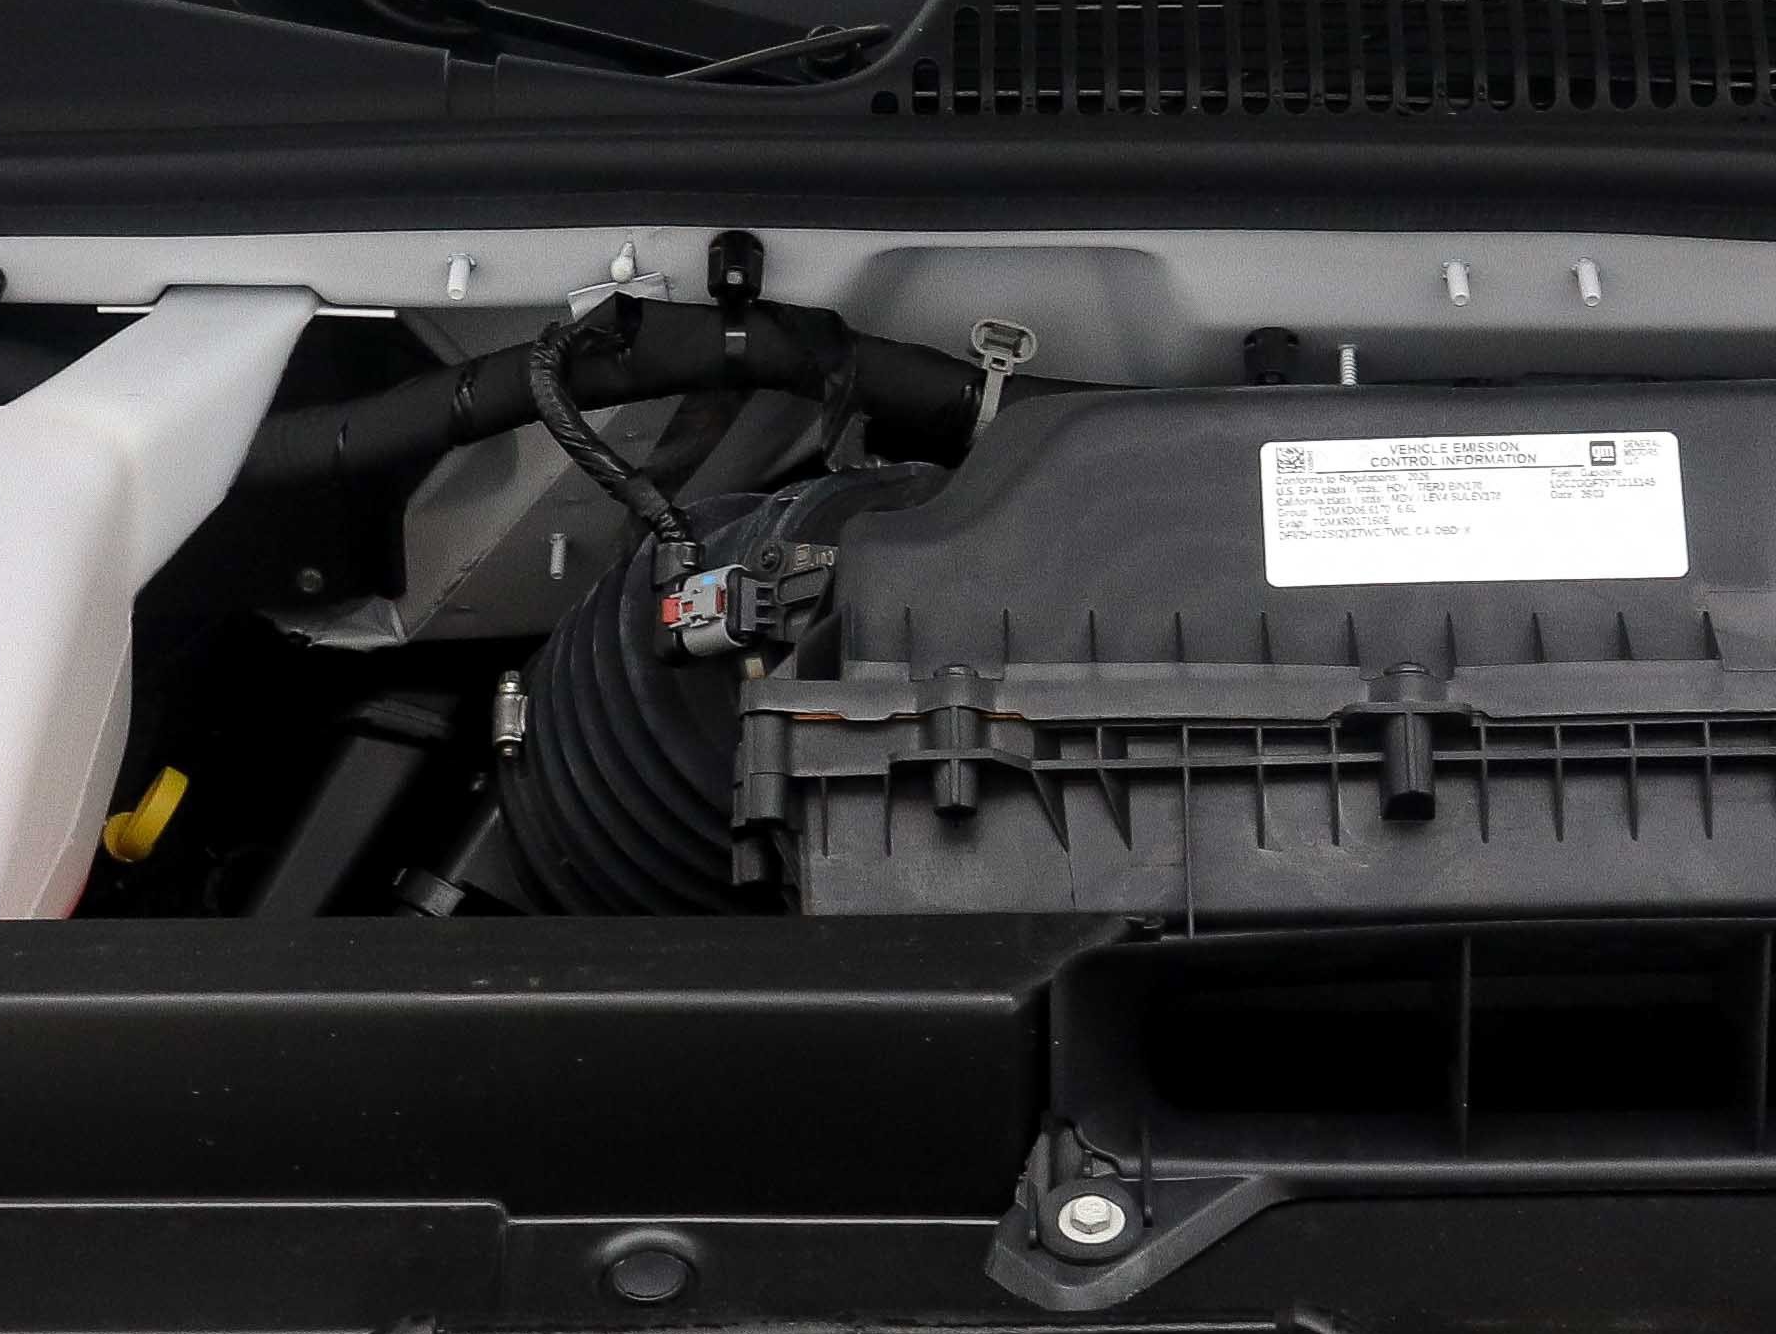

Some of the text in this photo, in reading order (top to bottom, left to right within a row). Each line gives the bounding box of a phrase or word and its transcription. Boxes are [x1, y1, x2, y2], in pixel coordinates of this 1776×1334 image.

[1390, 442, 1520, 455] VEHICLE EMISSION
[1370, 454, 1537, 468] CONTROL INFORMATION
